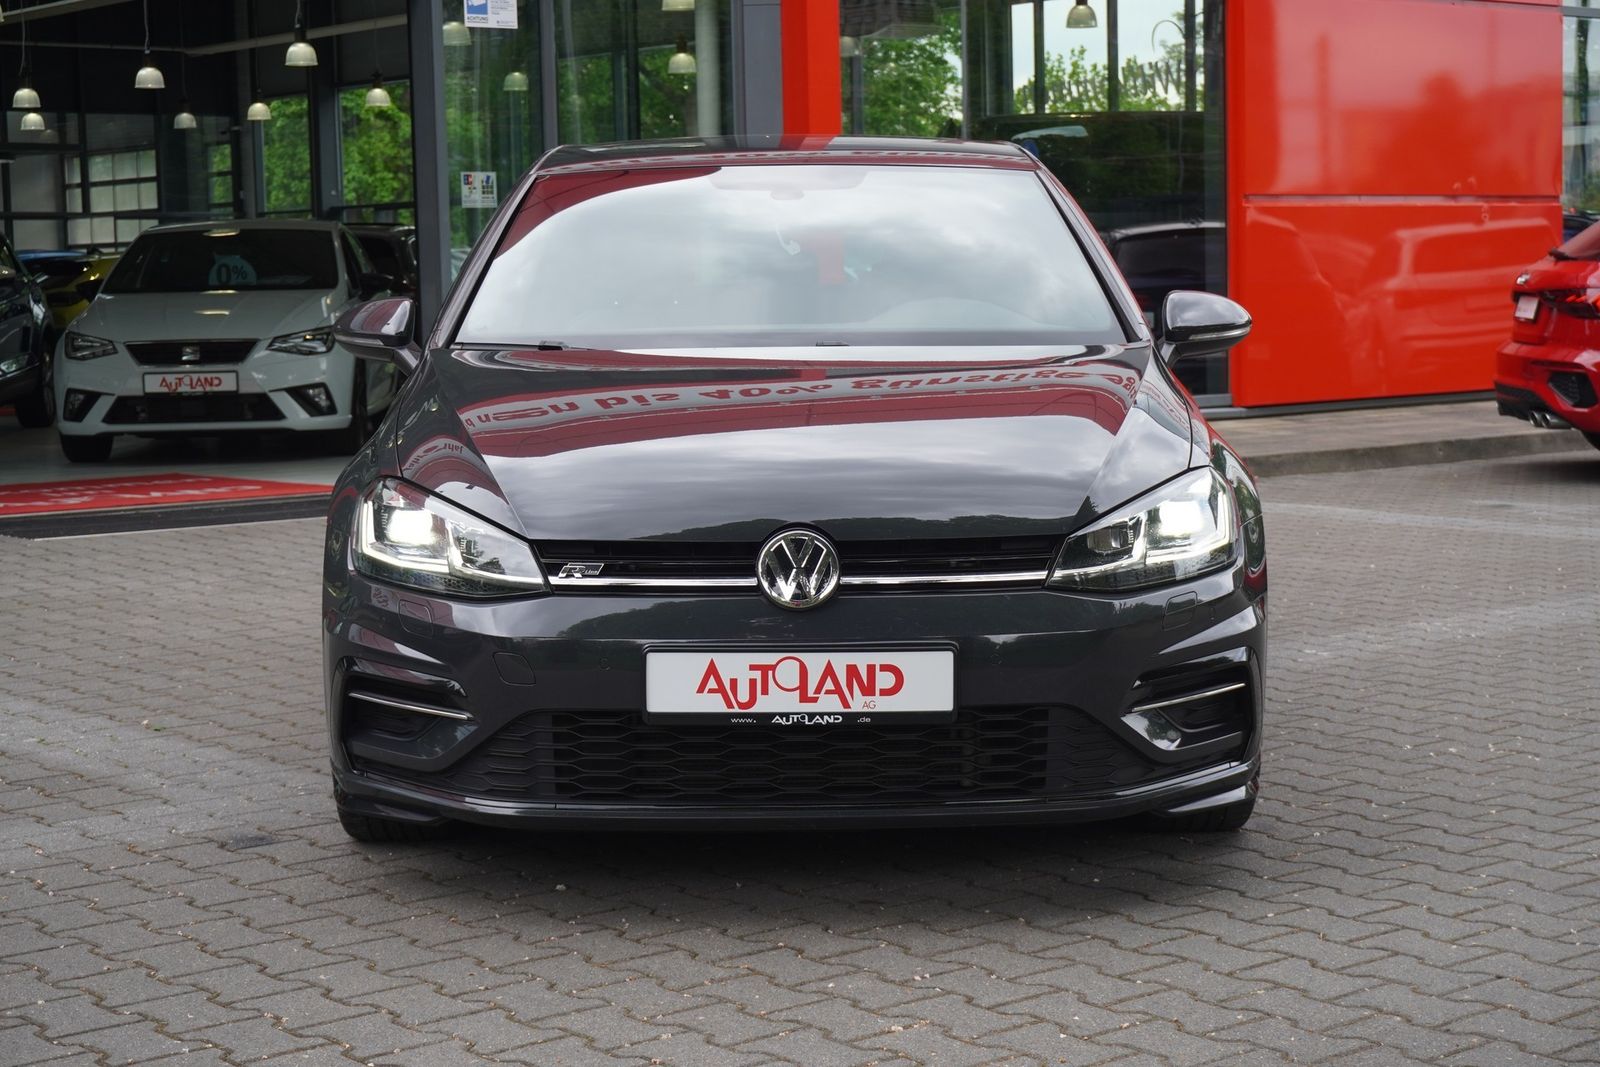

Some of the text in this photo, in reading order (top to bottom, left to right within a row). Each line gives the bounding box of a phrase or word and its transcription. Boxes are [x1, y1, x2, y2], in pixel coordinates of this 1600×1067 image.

[218, 264, 247, 283] 0%
[159, 374, 222, 391] AUTOLAND
[696, 655, 905, 710] AUTOLAND
[862, 700, 877, 710] AG
[771, 713, 843, 726] AUTOLAND
